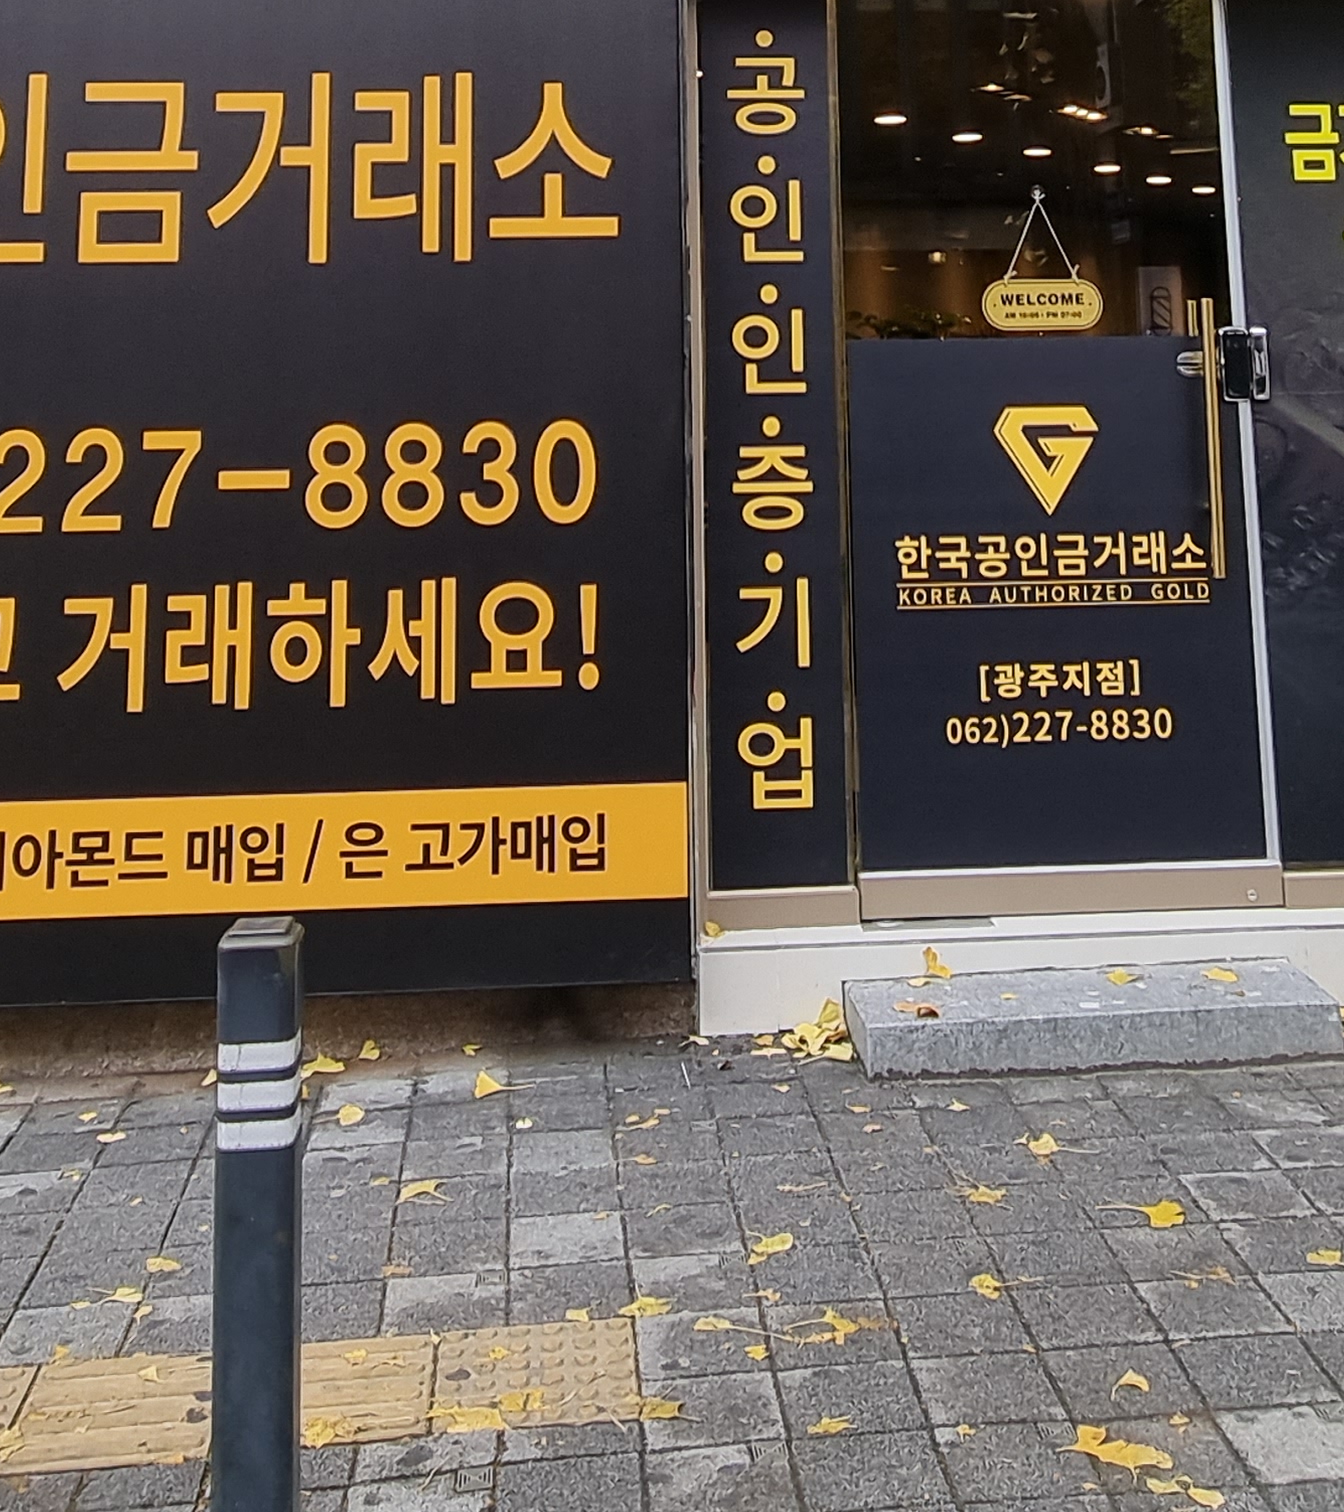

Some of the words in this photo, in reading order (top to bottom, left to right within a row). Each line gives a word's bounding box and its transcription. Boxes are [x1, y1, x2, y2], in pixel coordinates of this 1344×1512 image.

[1000, 292, 1086, 307] WELCOME
[722, 30, 815, 811] 공인인증기업
[894, 532, 1207, 580] 한국공인금거래소
[898, 584, 974, 606] KOREA
[988, 583, 1133, 605] AUTHORIZED
[1150, 582, 1210, 602] GOLD
[56, 577, 601, 715] 거래하세요!
[979, 659, 1142, 703] [광주지점]
[945, 707, 1174, 749] 062)227-8830
[184, 822, 287, 886] 매입
[339, 821, 390, 880] 은
[404, 812, 608, 875] 고가매입
